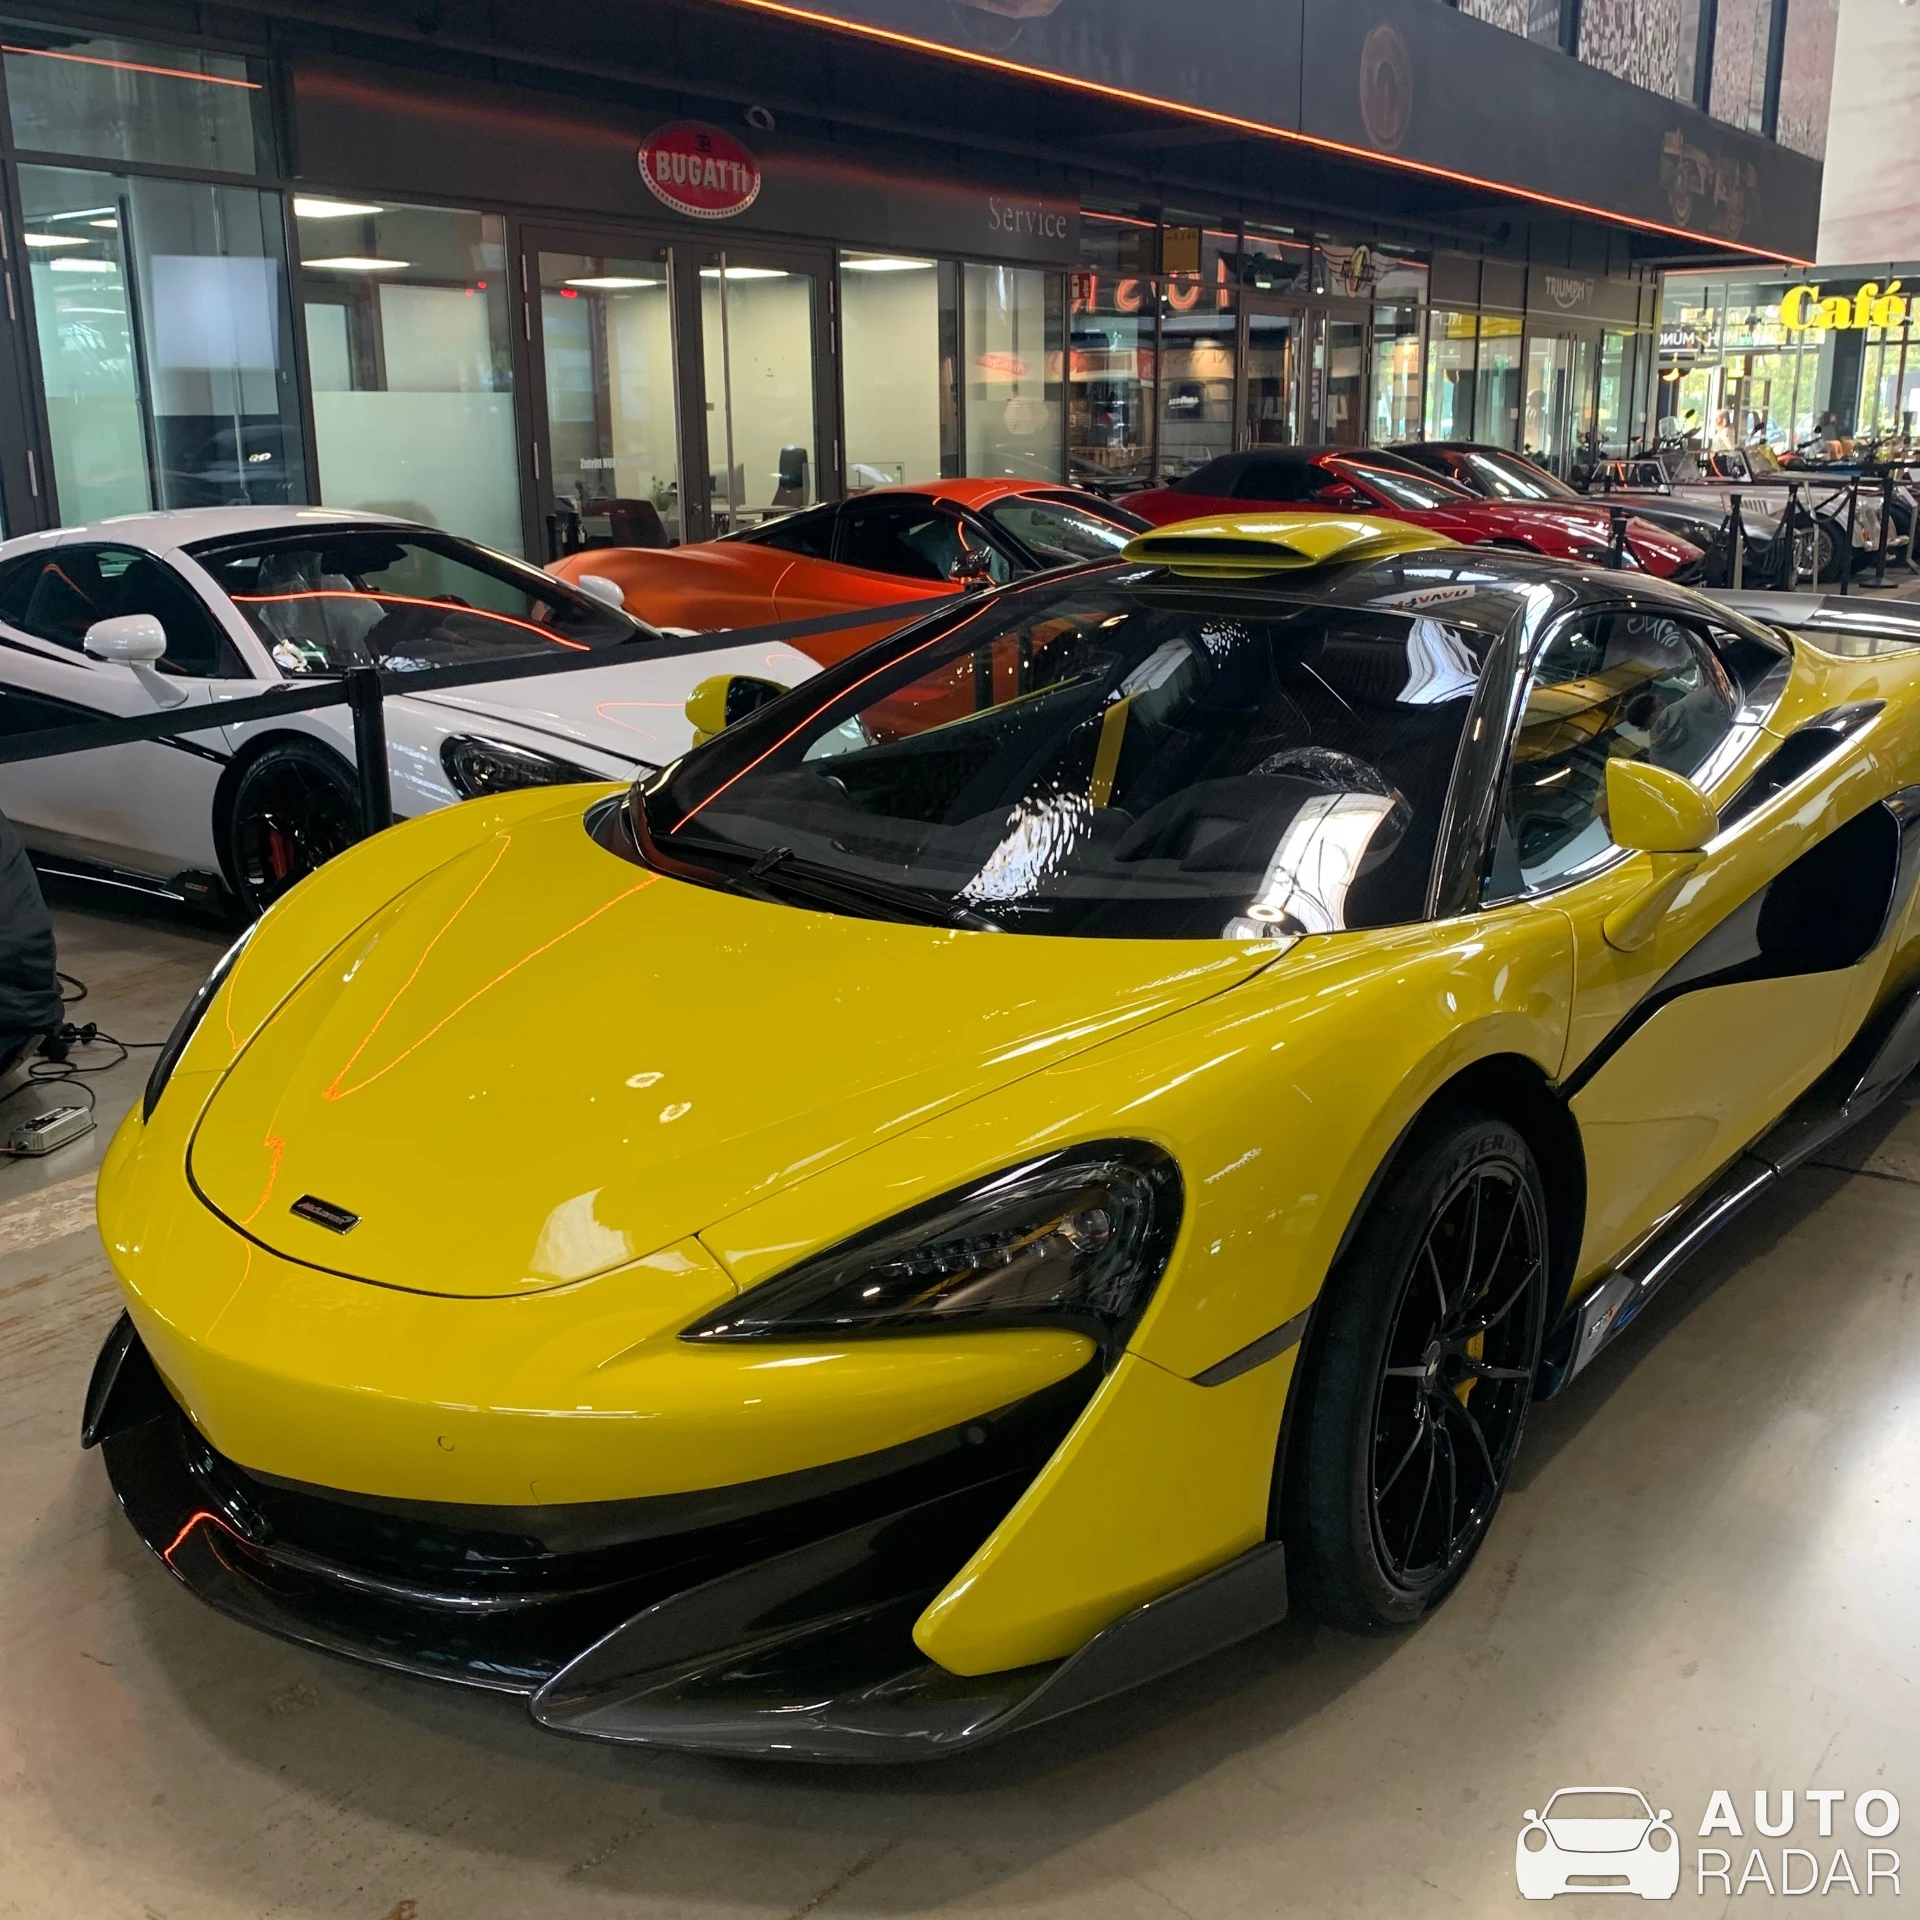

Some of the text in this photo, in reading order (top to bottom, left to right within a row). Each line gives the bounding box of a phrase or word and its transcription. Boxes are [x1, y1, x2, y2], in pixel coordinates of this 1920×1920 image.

[655, 150, 750, 193] BUGATTI
[989, 198, 1066, 238] Service
[1545, 275, 1585, 307] TRIUMPH
[1780, 280, 1906, 331] Café
